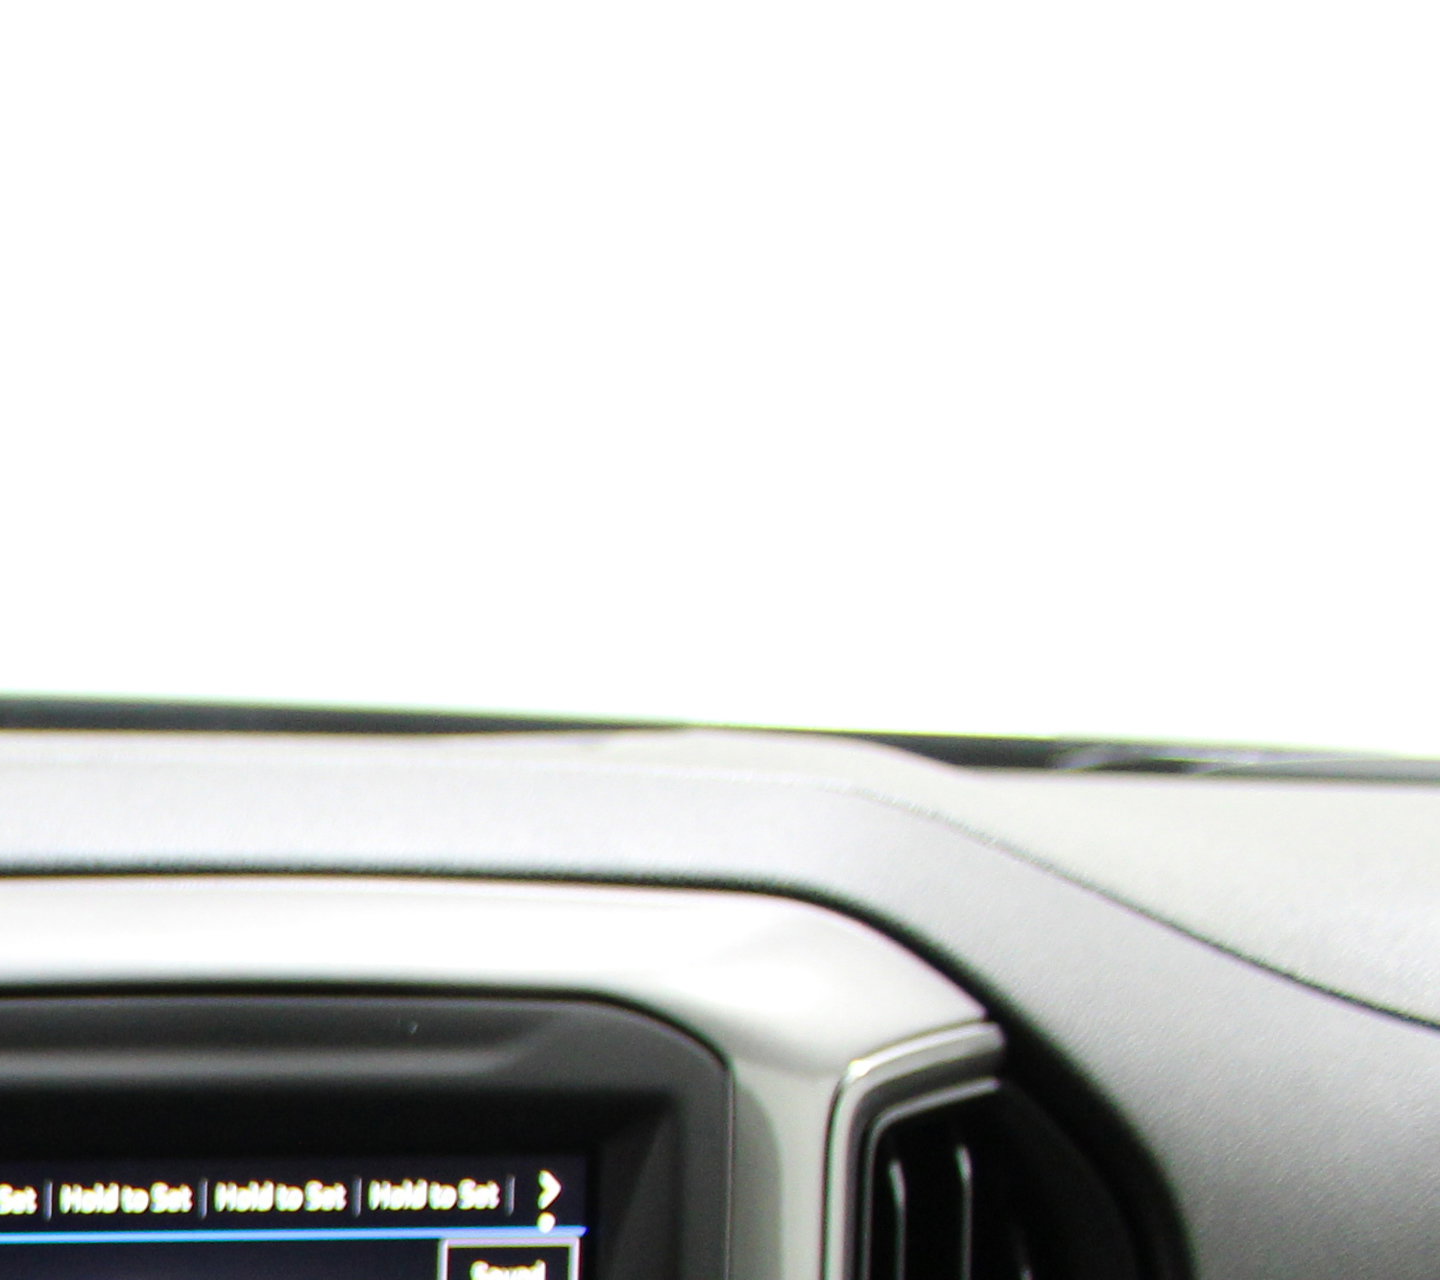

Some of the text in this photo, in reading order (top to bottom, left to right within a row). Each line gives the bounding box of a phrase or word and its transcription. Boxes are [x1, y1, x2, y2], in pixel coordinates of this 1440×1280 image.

[60, 1181, 192, 1214] Hold to Set
[215, 1179, 346, 1212] Hold to Set
[369, 1177, 499, 1210] Hold to Set
